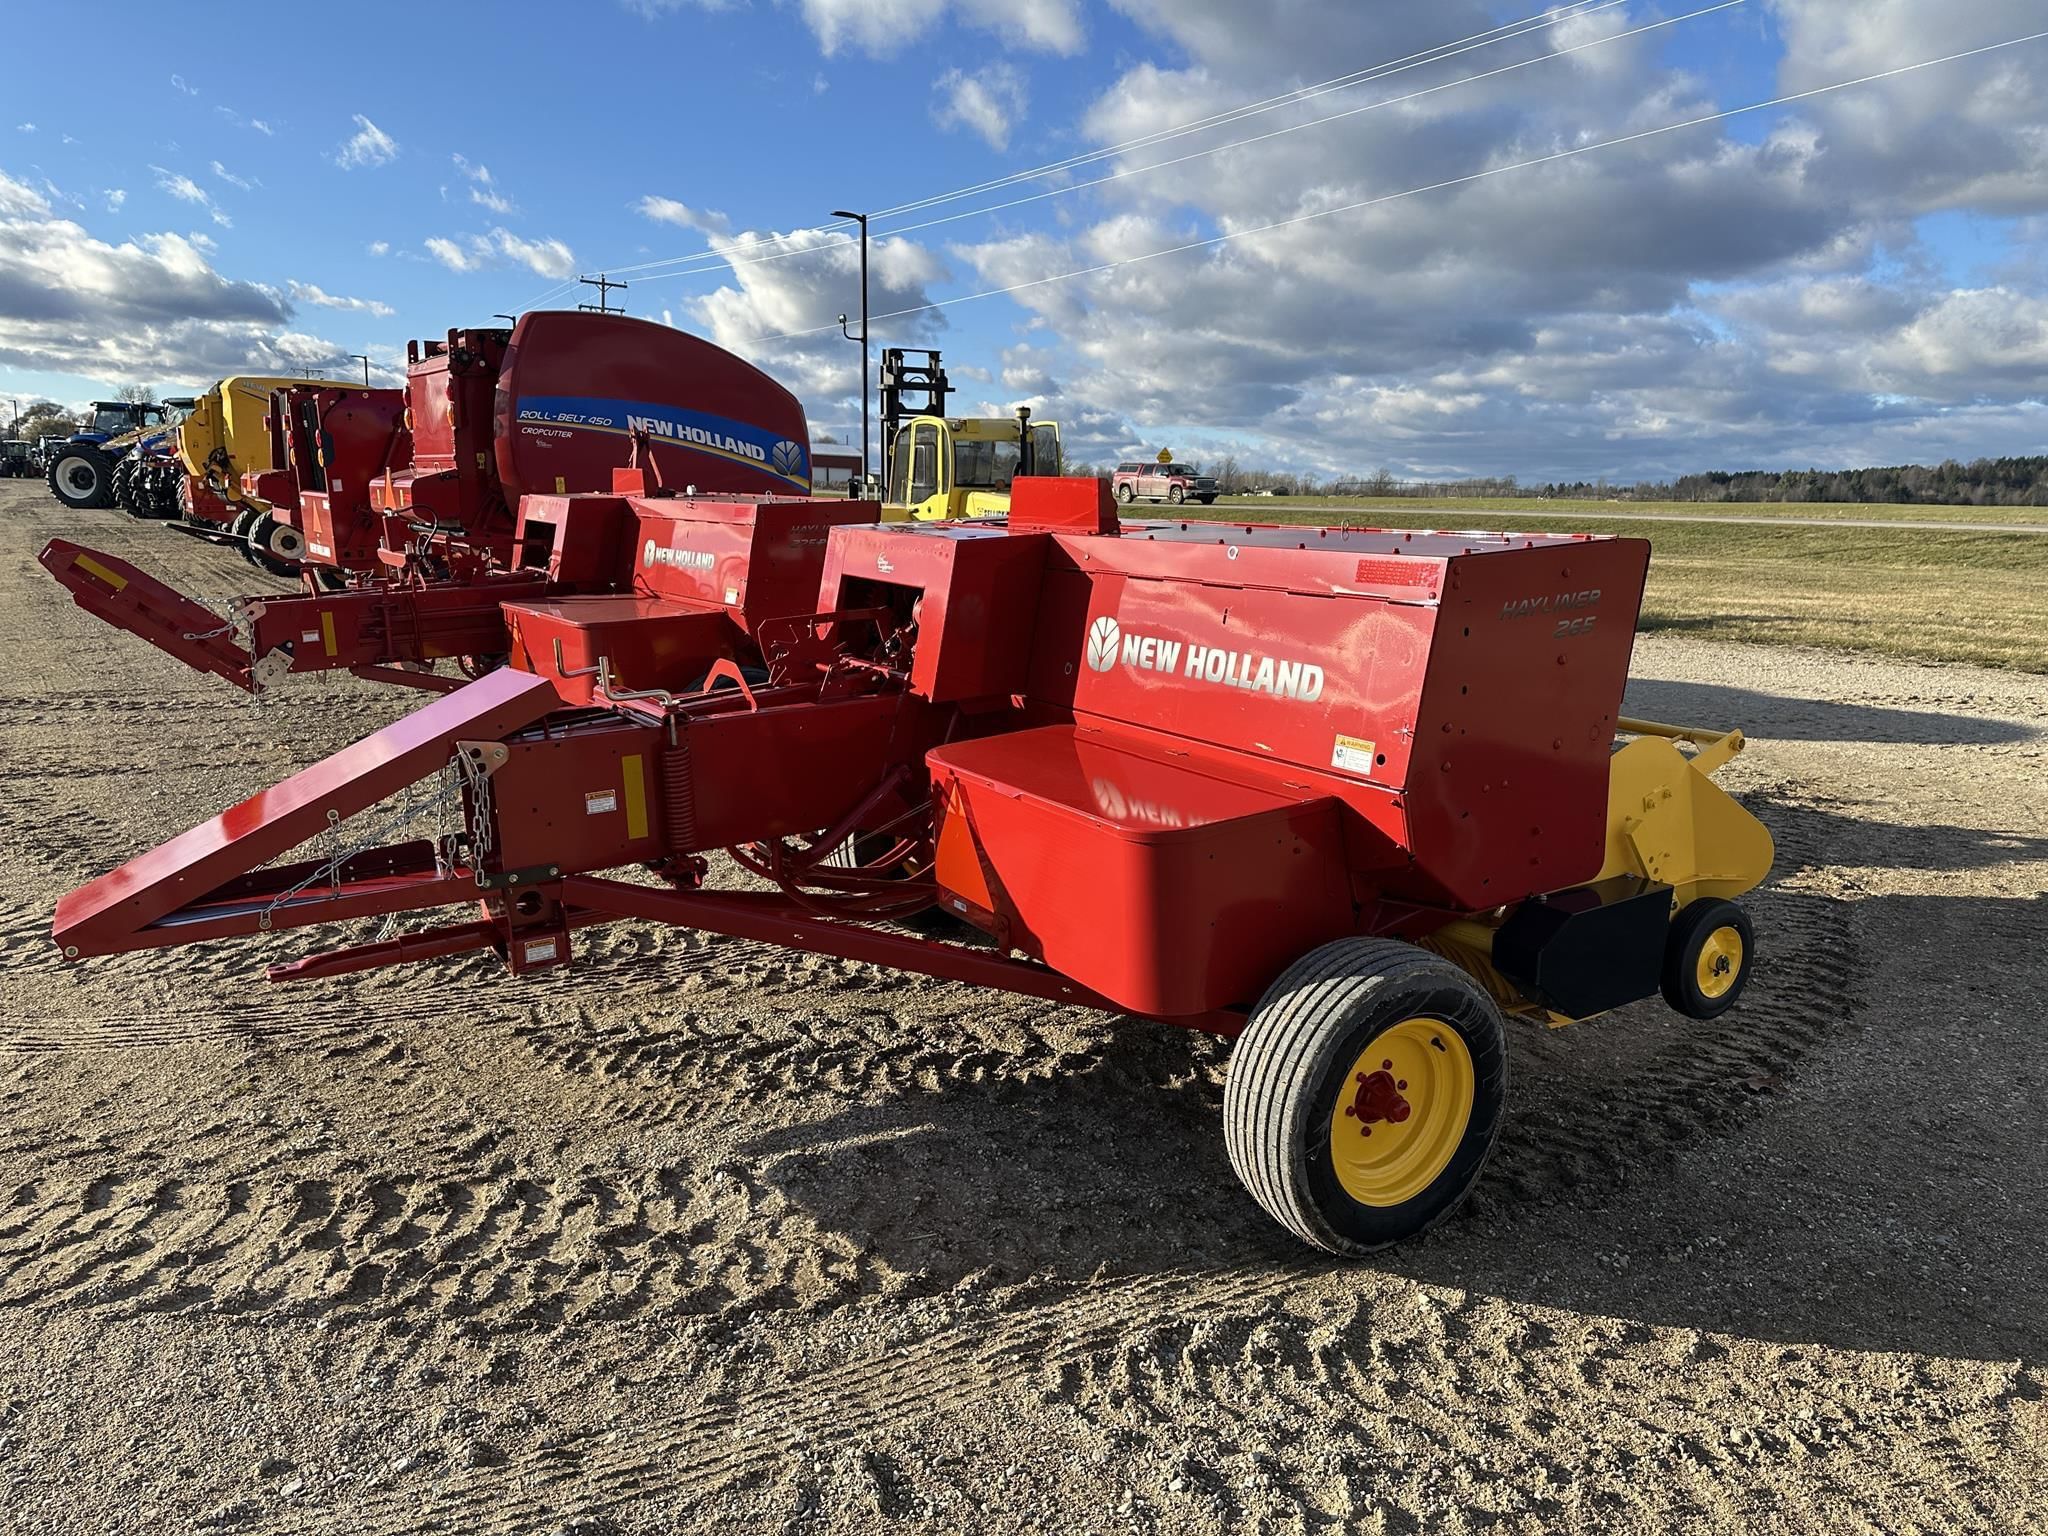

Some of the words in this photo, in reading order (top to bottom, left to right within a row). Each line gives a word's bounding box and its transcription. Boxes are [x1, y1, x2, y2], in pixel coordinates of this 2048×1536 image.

[519, 410, 586, 423] ROLL-BELT
[588, 416, 613, 426] 450
[521, 427, 573, 438] CROPCUTTER
[626, 414, 673, 437] NEW
[676, 424, 766, 461] HOLLAND
[655, 546, 675, 564] NEW
[675, 548, 715, 570] HOLLAND
[1498, 589, 1601, 621] HAYLINER
[1552, 615, 1597, 639] 265
[1120, 633, 1182, 674] NEW
[1183, 643, 1325, 703] HOLLAND
